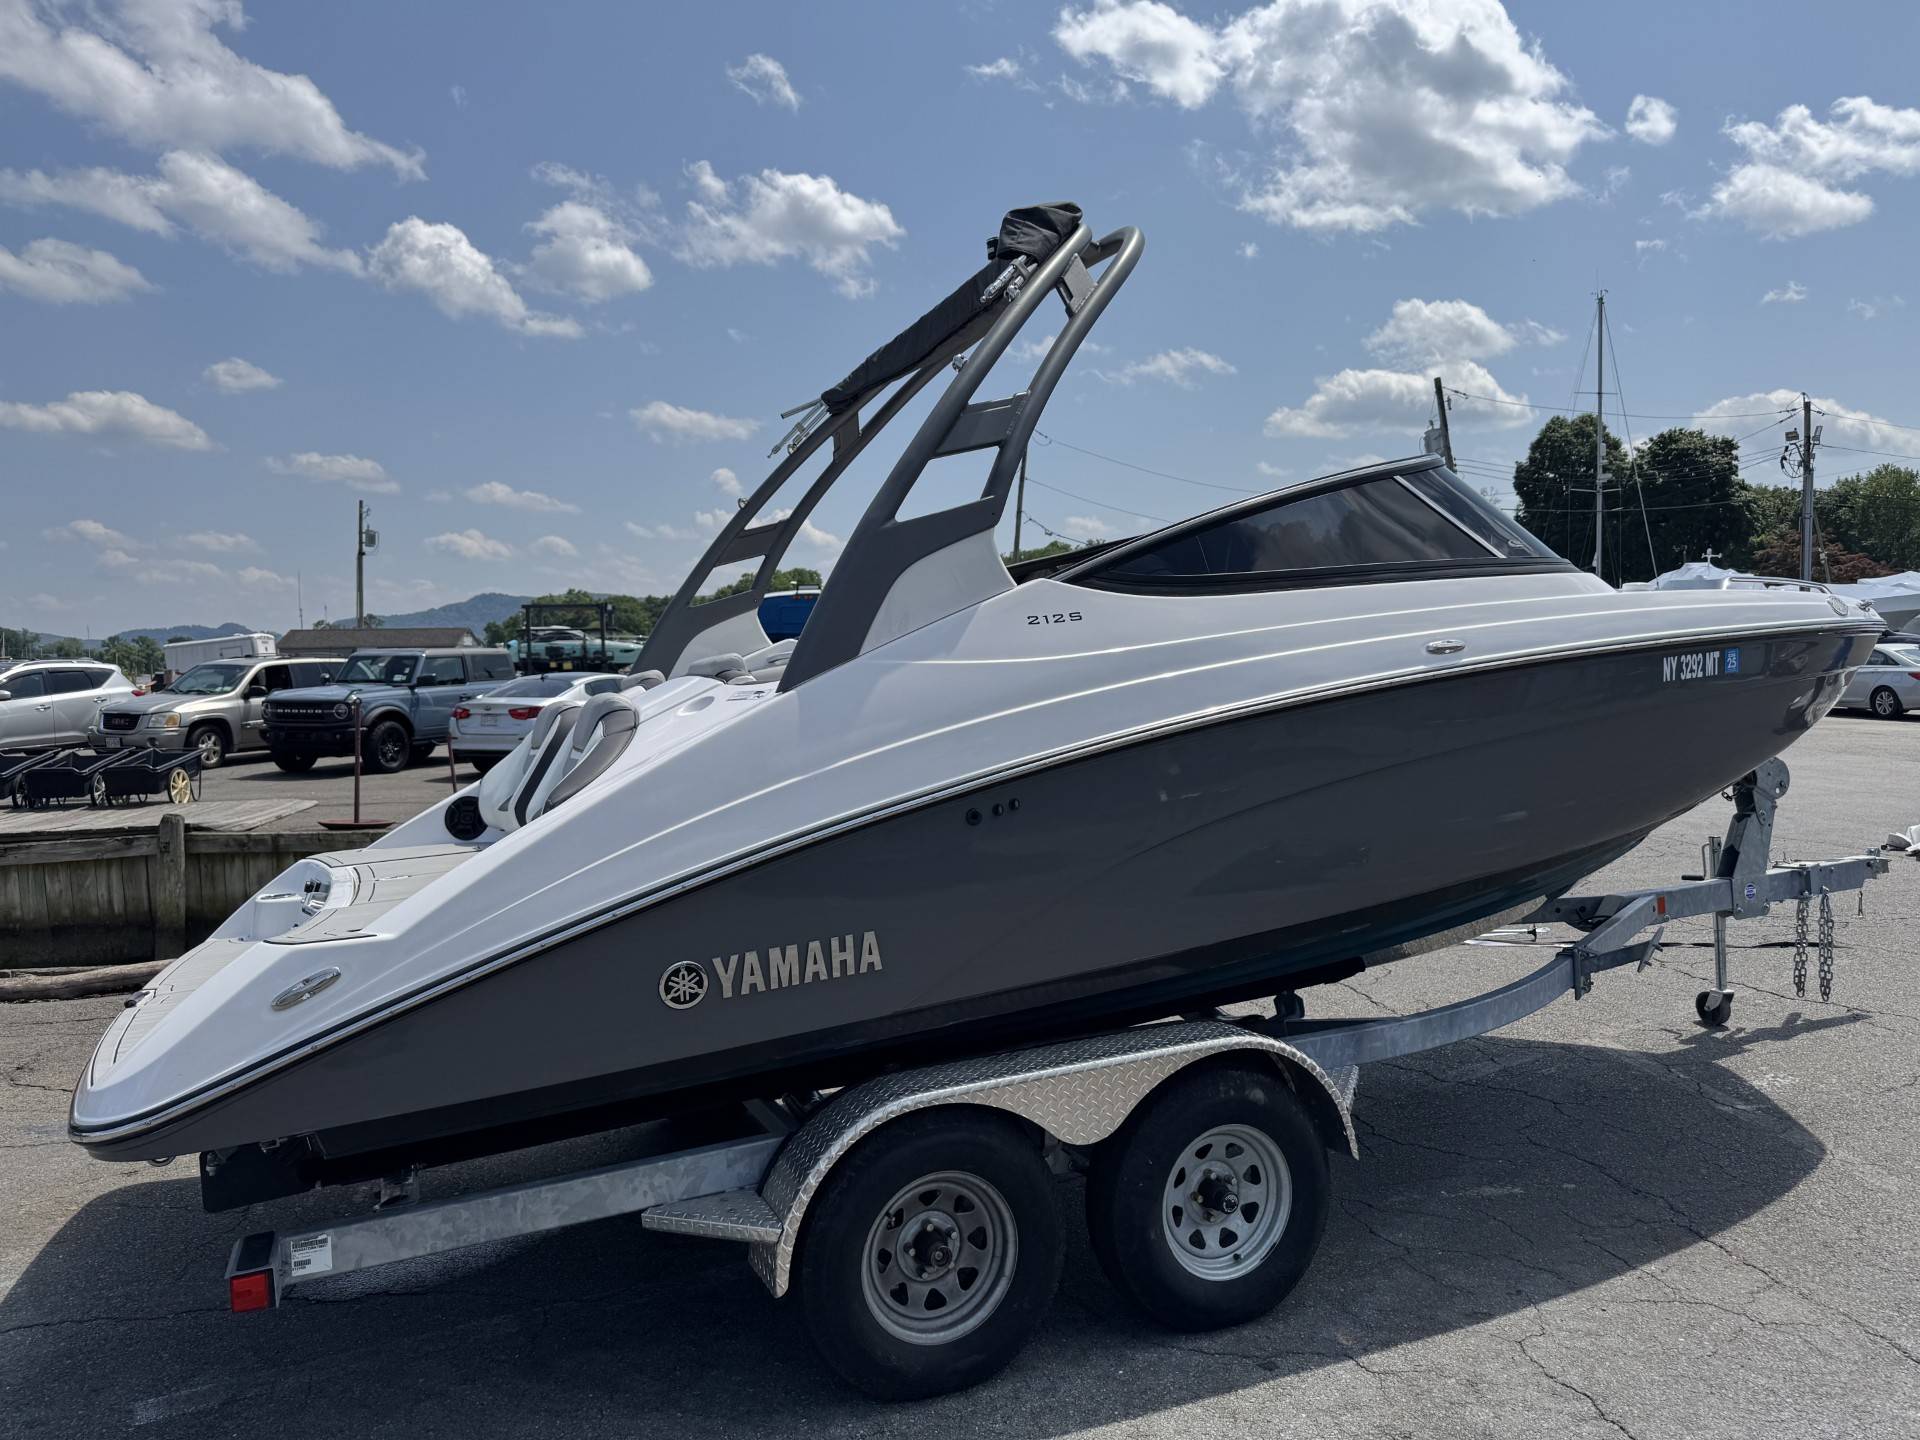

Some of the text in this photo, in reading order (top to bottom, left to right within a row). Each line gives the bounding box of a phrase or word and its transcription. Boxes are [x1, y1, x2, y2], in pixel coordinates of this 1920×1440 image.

[1027, 611, 1083, 625] 212S
[1663, 651, 1720, 682] NY 3292 MT
[712, 931, 883, 999] YAMAHA
